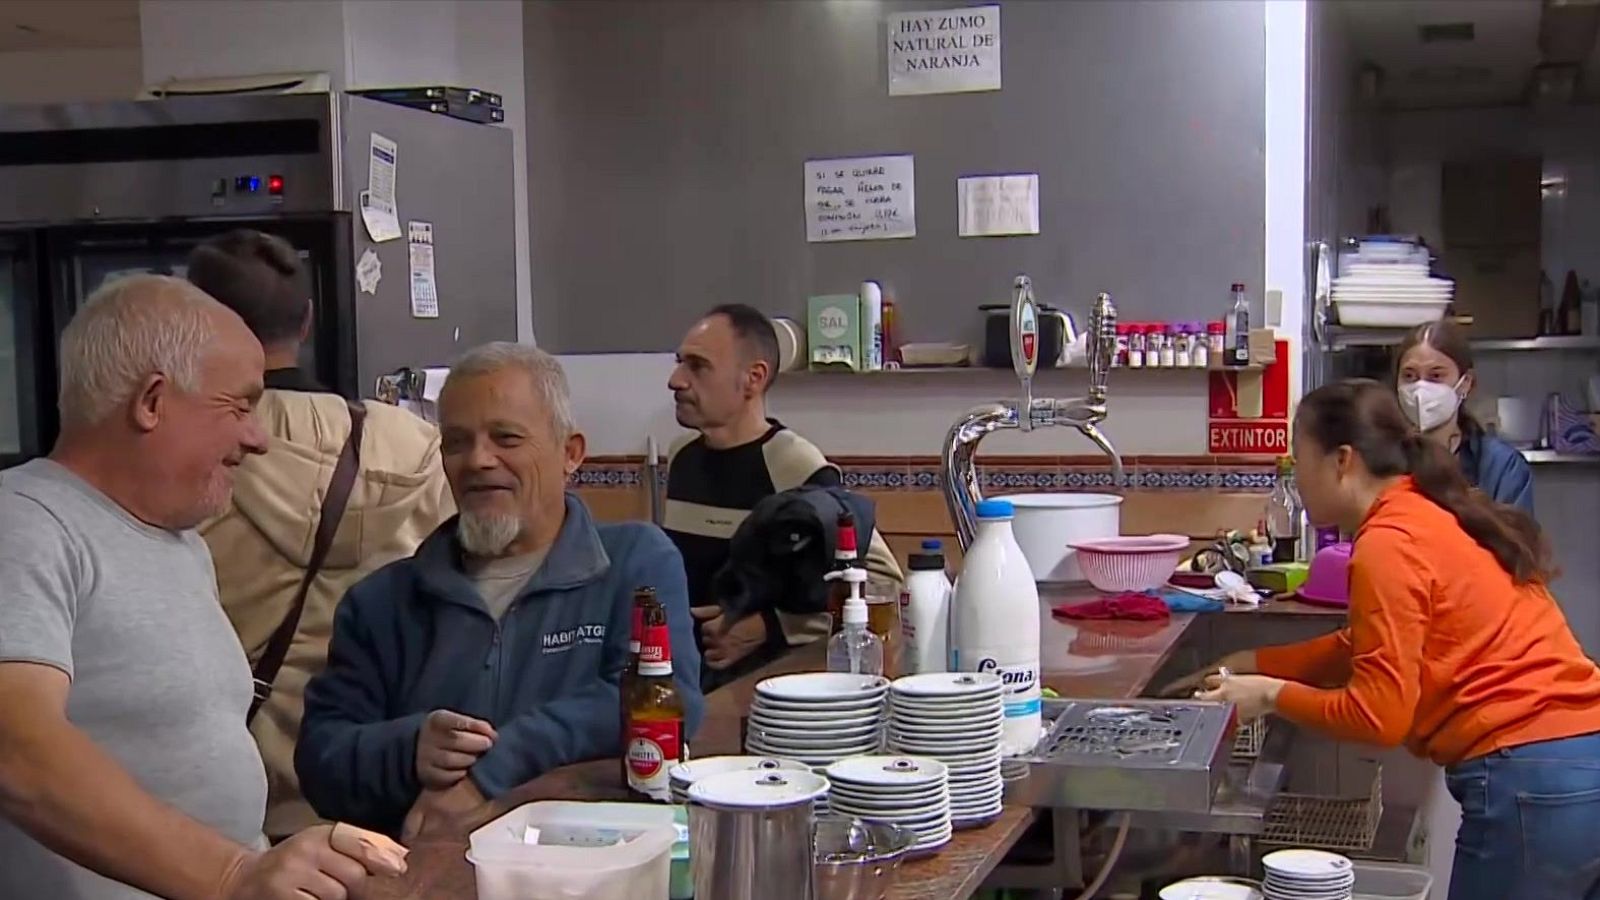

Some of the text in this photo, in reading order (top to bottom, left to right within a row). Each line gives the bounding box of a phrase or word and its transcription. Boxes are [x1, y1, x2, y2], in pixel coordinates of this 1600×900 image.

[900, 15, 985, 33] HAY ZUMO
[893, 34, 994, 54] NATURAL DE
[906, 54, 980, 71] NARANJA
[820, 316, 846, 329] SAL
[1210, 428, 1286, 448] EXTINTOR
